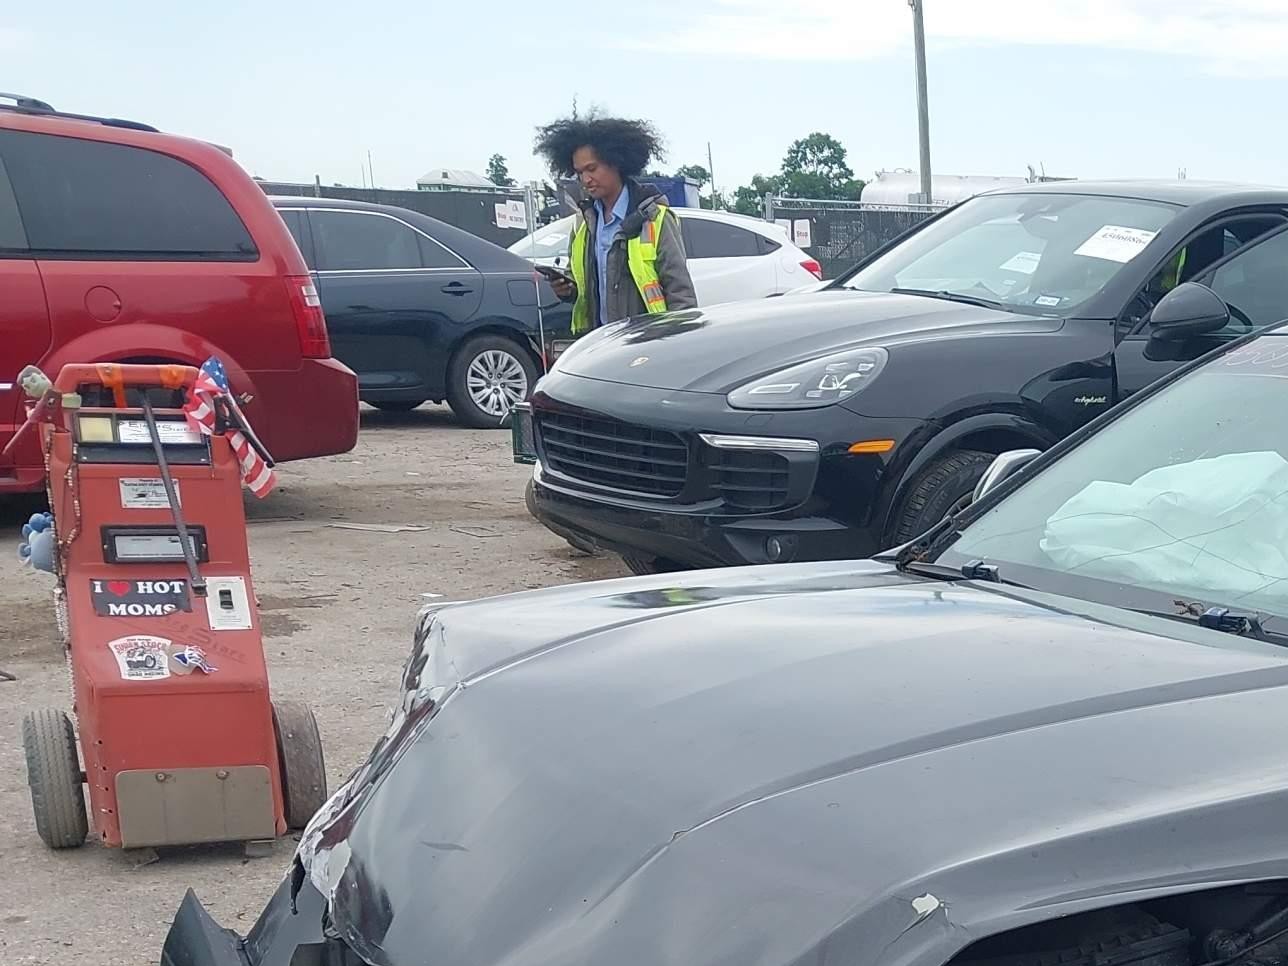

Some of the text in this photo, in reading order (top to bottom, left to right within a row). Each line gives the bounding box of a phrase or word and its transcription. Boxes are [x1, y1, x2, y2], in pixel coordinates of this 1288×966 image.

[93, 581, 184, 594] I HOT
[108, 603, 176, 616] MOMS
